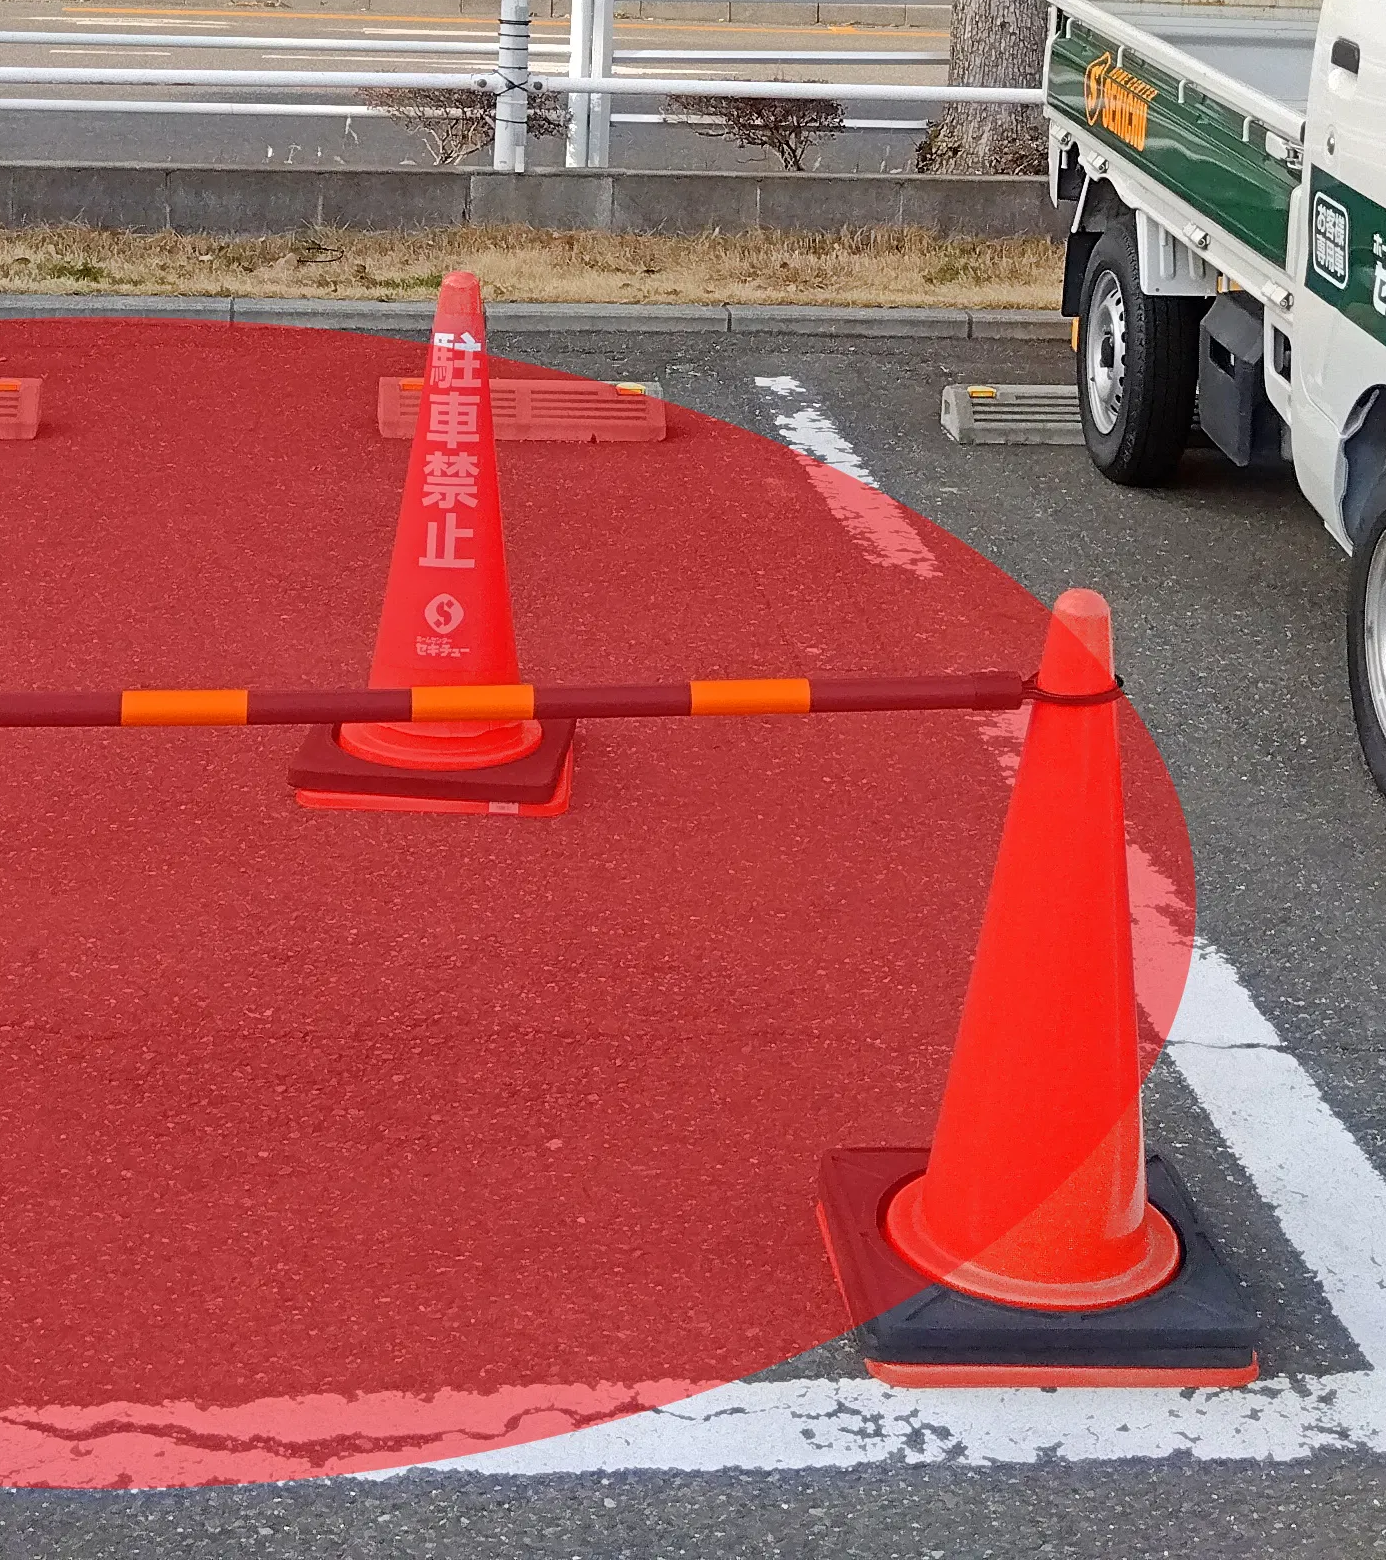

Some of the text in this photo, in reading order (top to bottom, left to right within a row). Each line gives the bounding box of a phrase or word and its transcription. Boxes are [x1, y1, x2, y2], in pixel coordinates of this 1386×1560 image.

[418, 331, 483, 569] 駐車禁止
[415, 642, 471, 658] セキチュー
